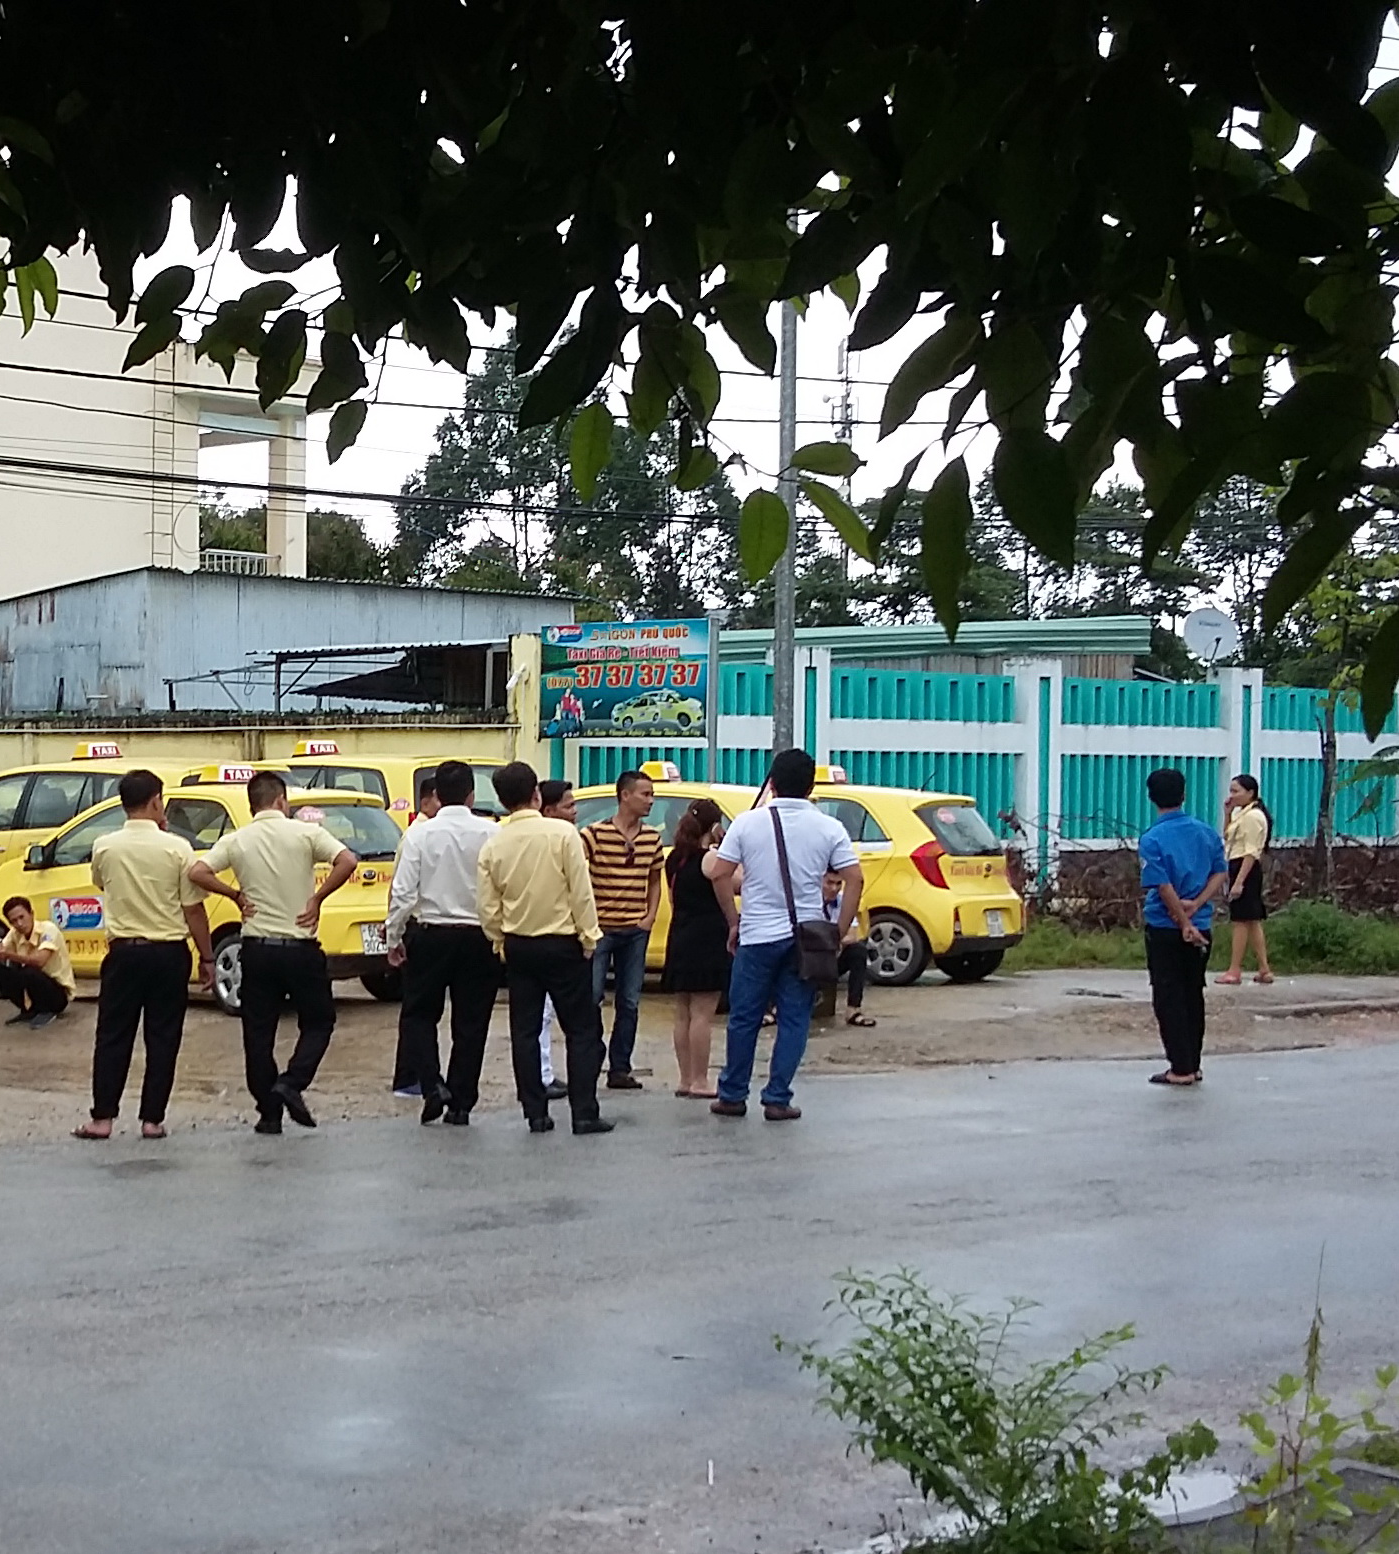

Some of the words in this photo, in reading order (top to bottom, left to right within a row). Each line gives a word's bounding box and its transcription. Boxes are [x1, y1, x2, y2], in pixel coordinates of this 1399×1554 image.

[567, 647, 588, 661] Taxi
[575, 663, 604, 688] 37
[606, 663, 635, 688] 37
[639, 662, 667, 687] 37
[671, 662, 700, 687] 37
[94, 746, 117, 756] TAXI
[312, 743, 336, 753] TAXI
